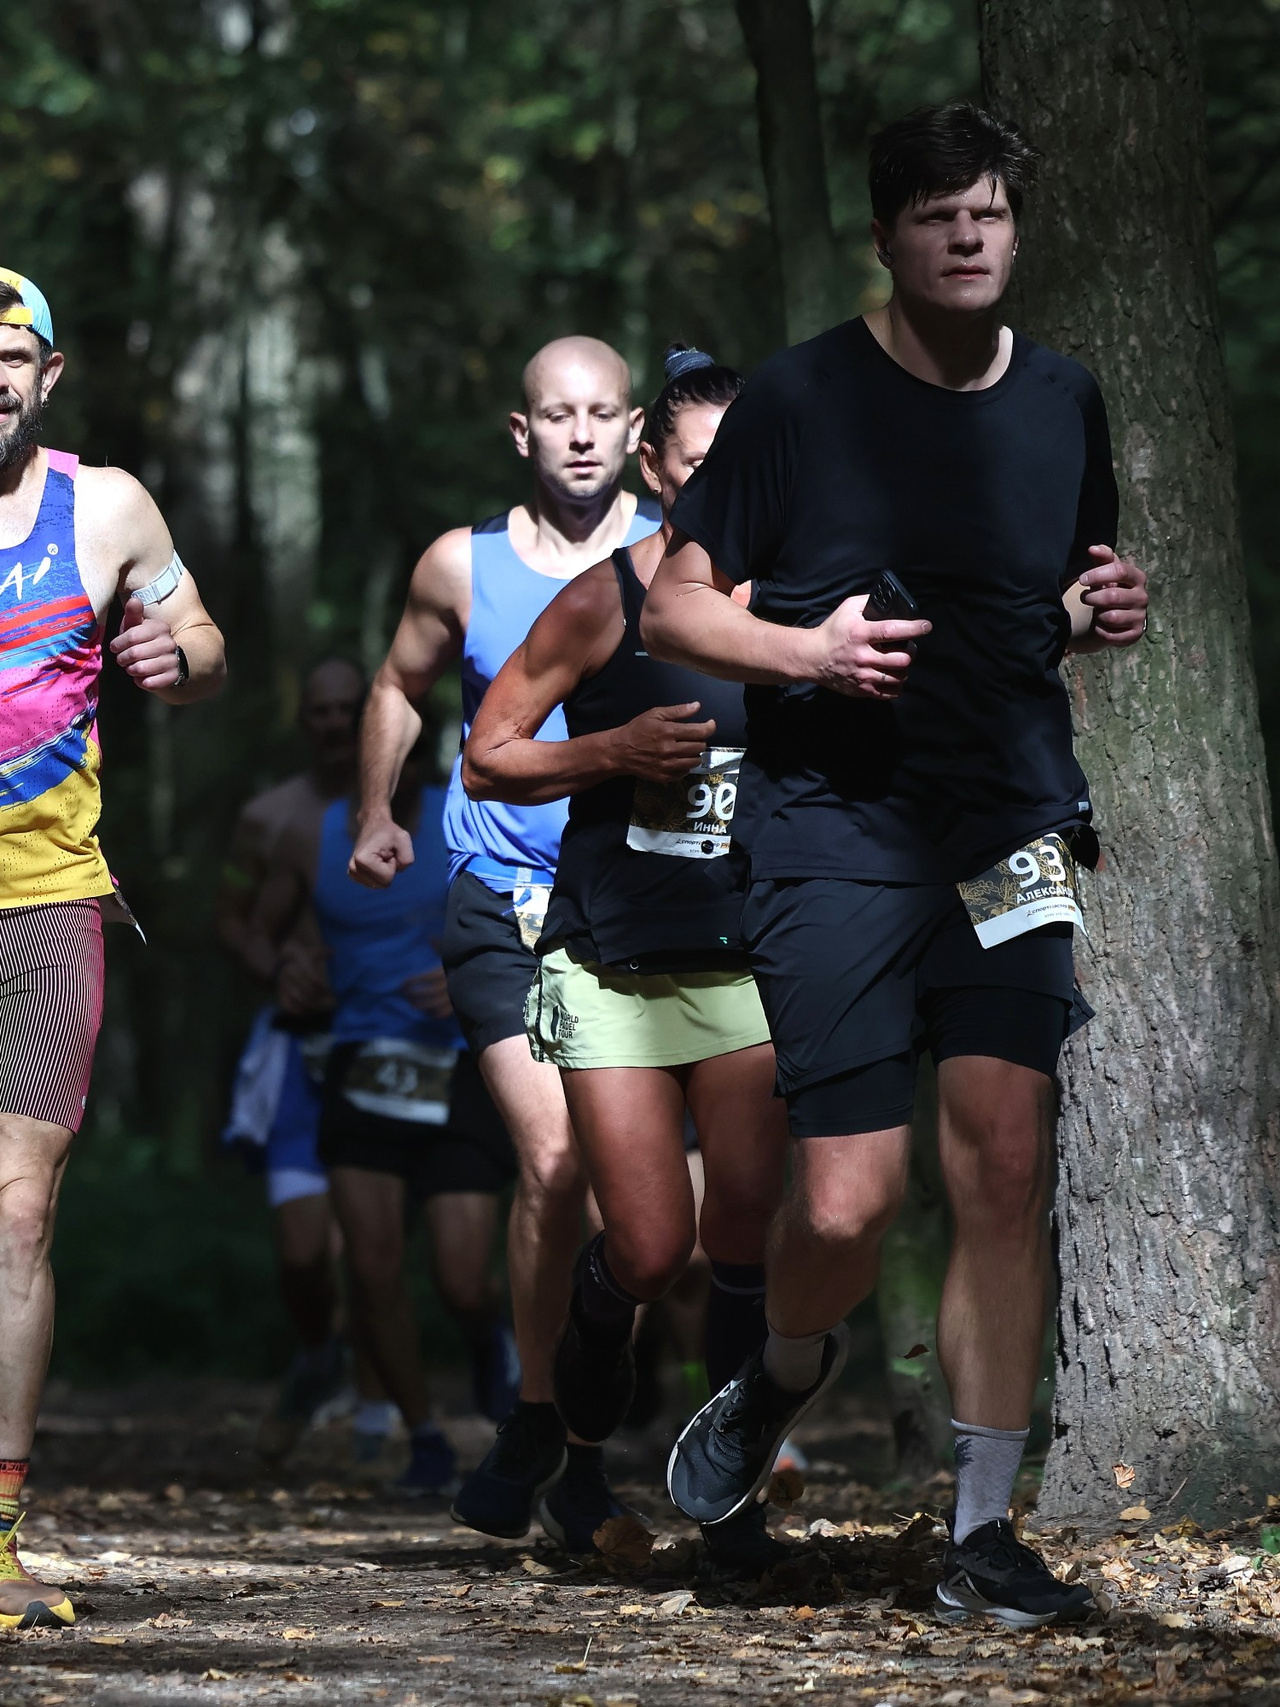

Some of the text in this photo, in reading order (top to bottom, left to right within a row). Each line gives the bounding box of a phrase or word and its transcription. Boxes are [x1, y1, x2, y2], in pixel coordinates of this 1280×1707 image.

[686, 782, 737, 821] 90
[1008, 845, 1067, 889] 93
[559, 1029, 573, 1039] TOUR
